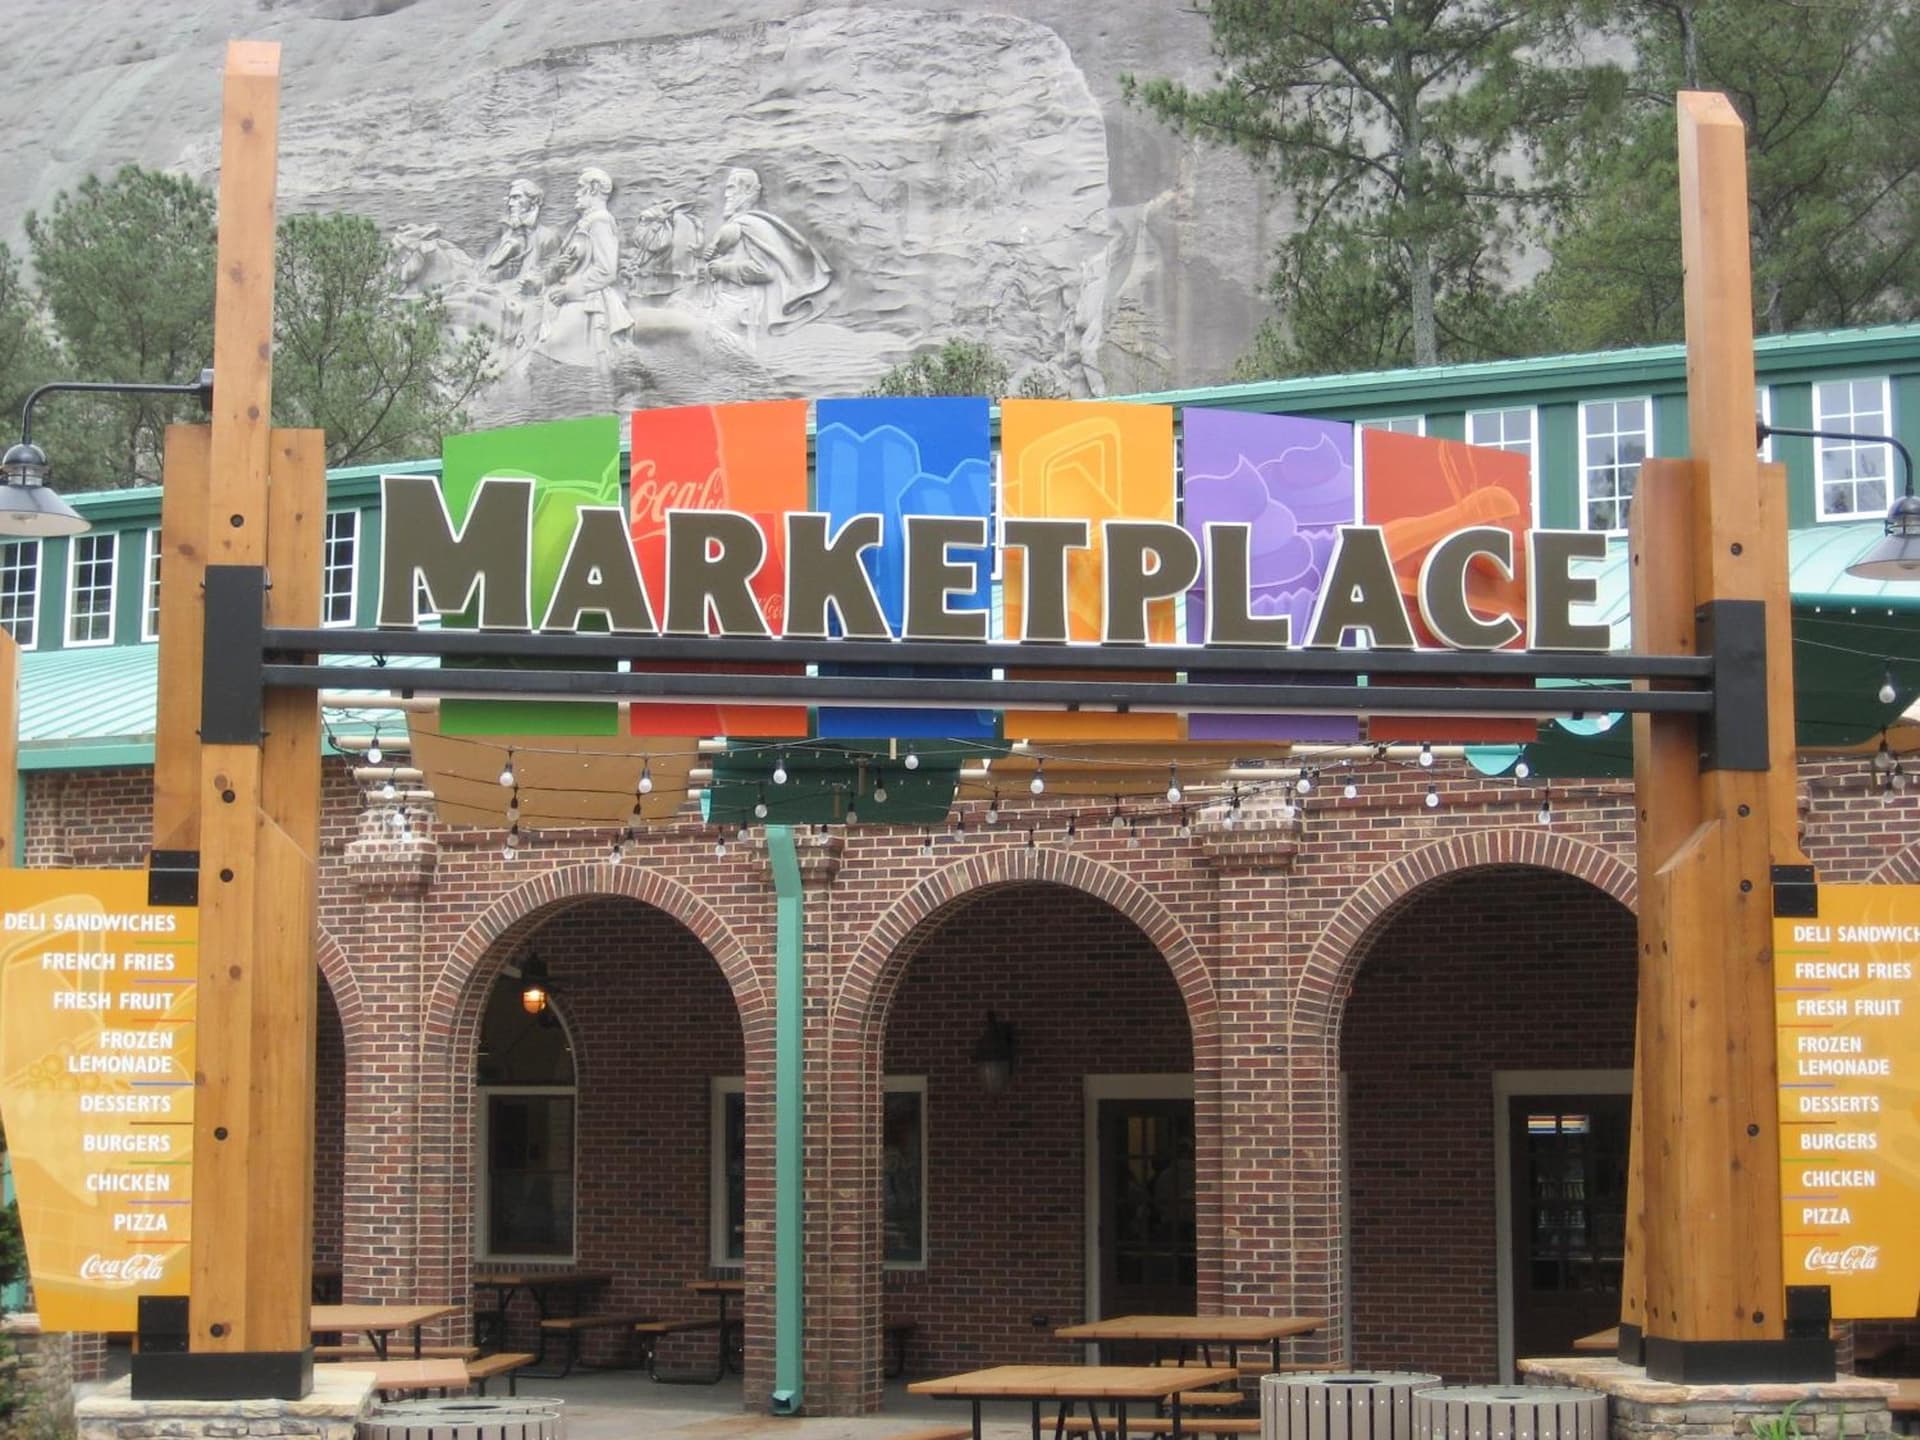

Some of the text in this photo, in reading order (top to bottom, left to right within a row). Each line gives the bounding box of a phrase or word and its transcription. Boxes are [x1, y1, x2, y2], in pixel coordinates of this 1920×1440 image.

[376, 475, 1611, 652] MARKETPLACE
[4, 912, 175, 932] DELI SANDWICHES
[1794, 926, 1830, 942] DELI
[42, 953, 174, 971] FRENCH FRIES
[1796, 963, 1912, 979] FRENCH FRIES
[53, 991, 172, 1010] FRESH FRUIT
[1797, 999, 1900, 1016] FRESH FRUIT
[100, 1031, 173, 1050] FROZEN
[1798, 1036, 1862, 1053] FROZEN
[68, 1055, 171, 1074] LEMONADE
[1799, 1059, 1889, 1076] LEMONADE
[79, 1094, 171, 1113] DESSERTS
[1800, 1096, 1879, 1113] DESSERTS
[83, 1133, 170, 1152] BURGERS
[1801, 1133, 1877, 1150] BURGERS
[86, 1173, 170, 1192] CHICKEN
[1803, 1171, 1875, 1187] CHICKEN
[113, 1213, 167, 1232] PIZZA
[1803, 1208, 1850, 1224] PIZZA
[80, 1253, 165, 1281] Coca-Cola
[1804, 1246, 1879, 1271] Coca-Cola
